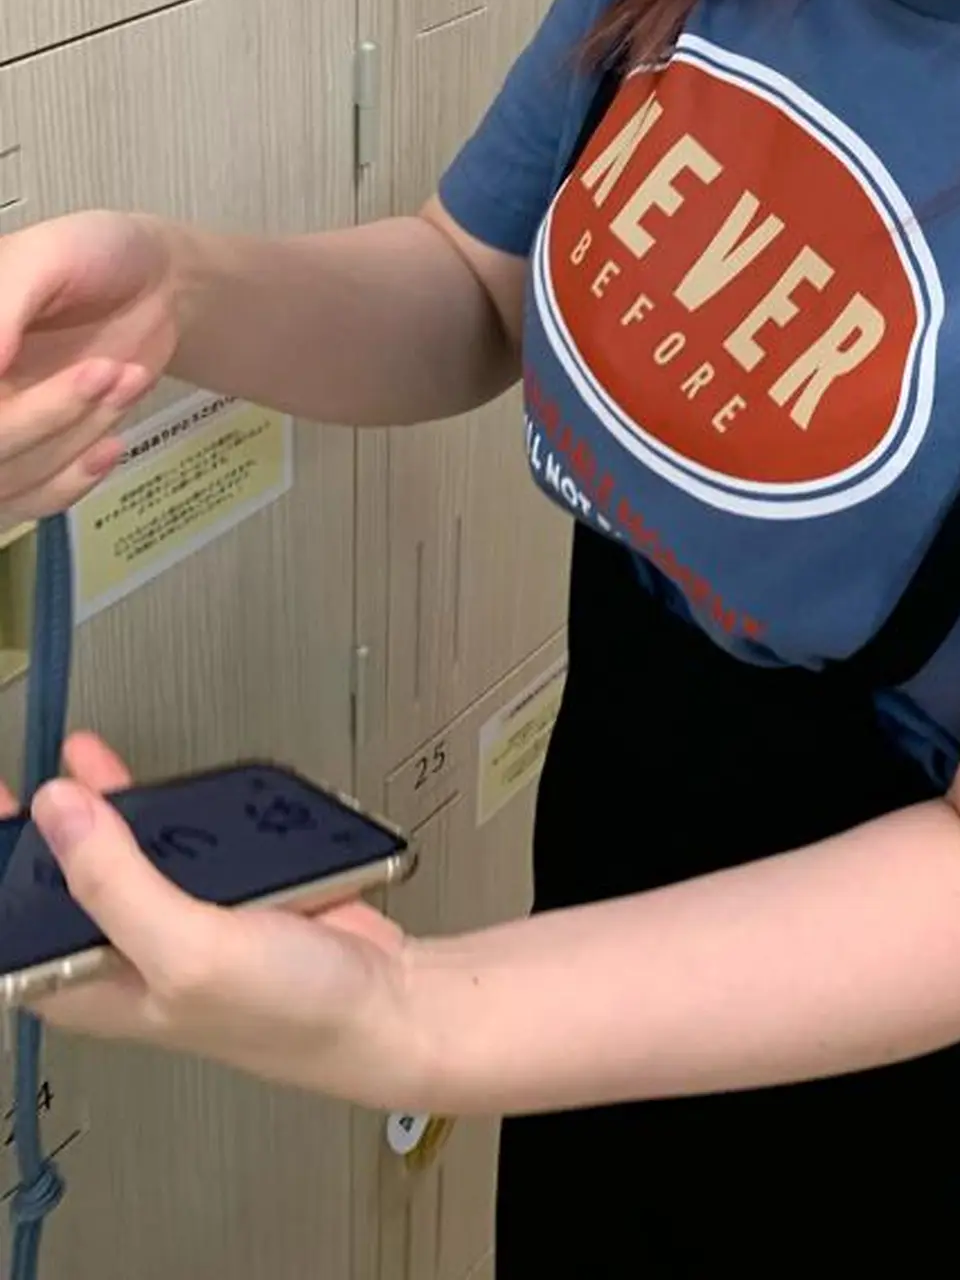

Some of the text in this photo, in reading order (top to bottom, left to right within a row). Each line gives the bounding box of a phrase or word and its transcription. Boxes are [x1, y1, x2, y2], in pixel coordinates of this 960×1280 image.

[570, 229, 748, 434] BEFORE
[579, 90, 886, 432] NEVER
[414, 740, 446, 791] 25
